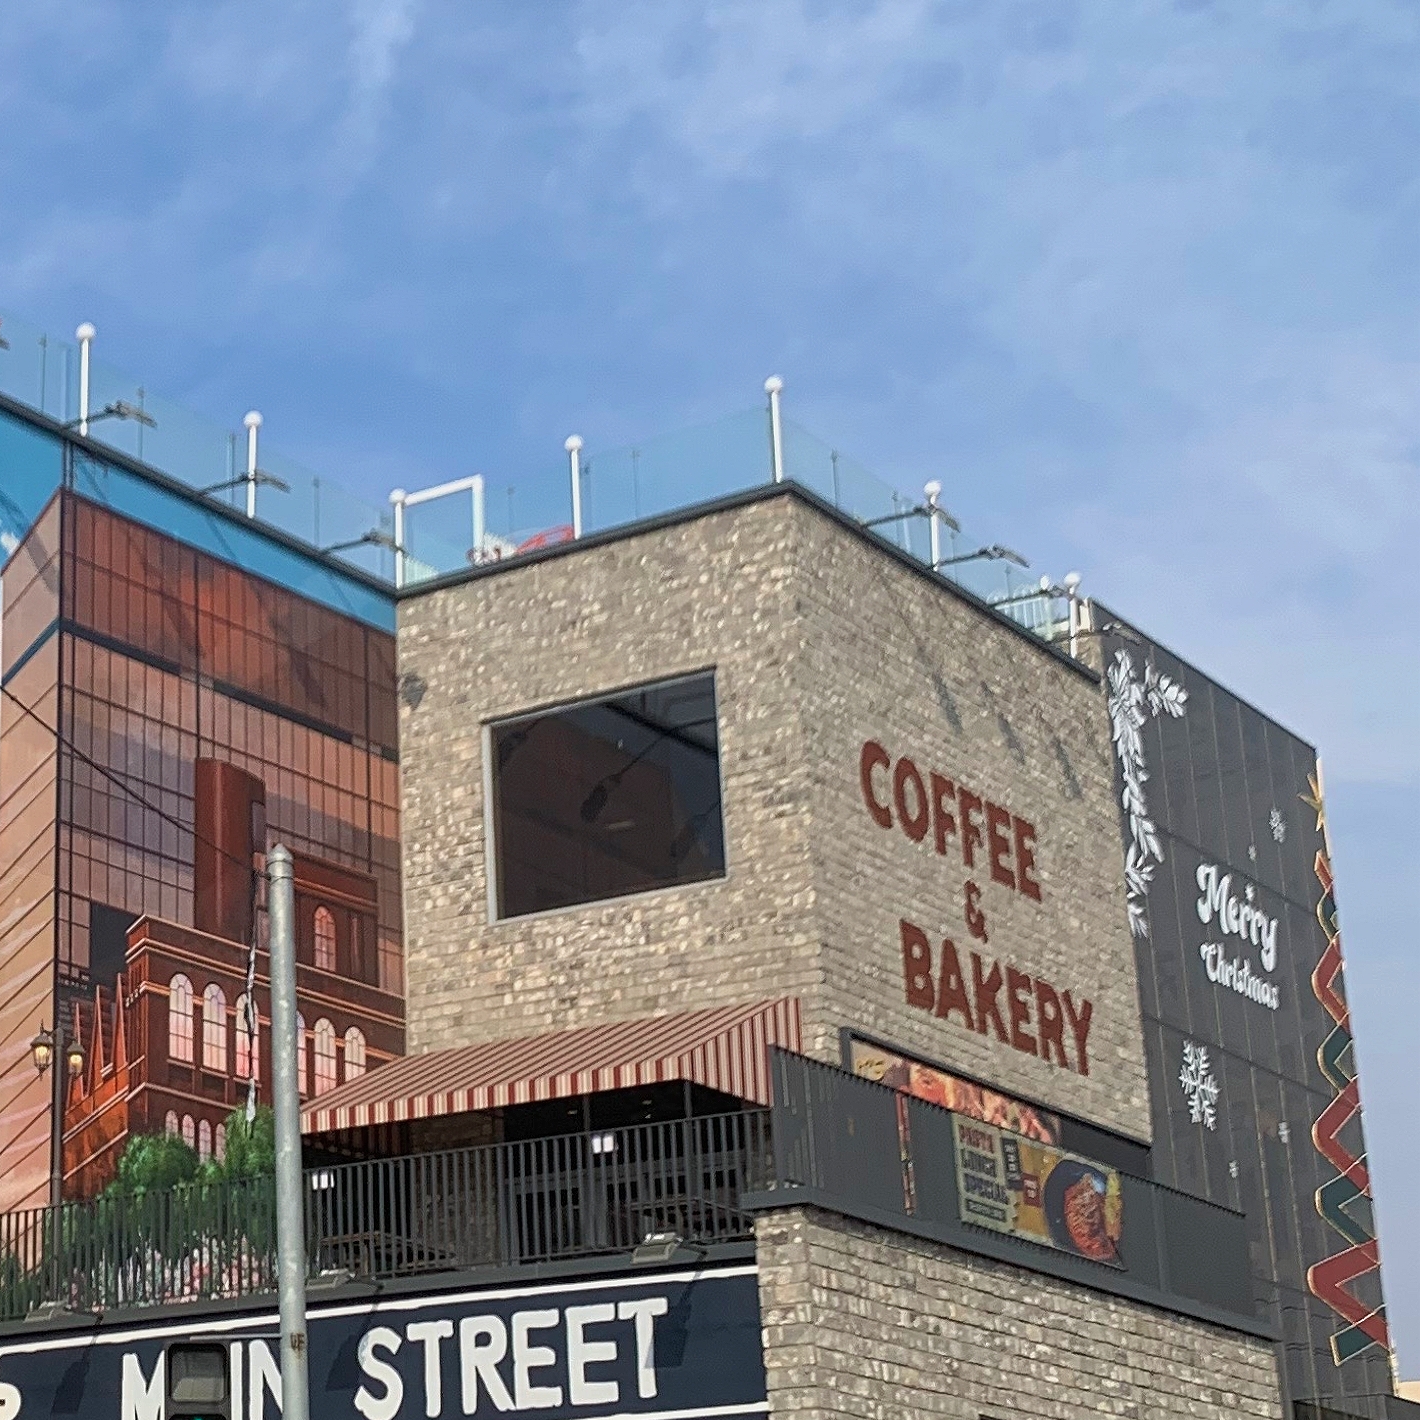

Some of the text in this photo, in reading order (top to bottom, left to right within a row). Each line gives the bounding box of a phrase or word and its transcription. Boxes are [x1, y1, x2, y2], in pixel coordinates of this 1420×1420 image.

[860, 740, 1042, 902] COFFEE
[964, 880, 988, 944] &
[1196, 863, 1278, 972] Merry
[899, 917, 1093, 1076] BAKERY
[1200, 942, 1280, 1010] Christmas
